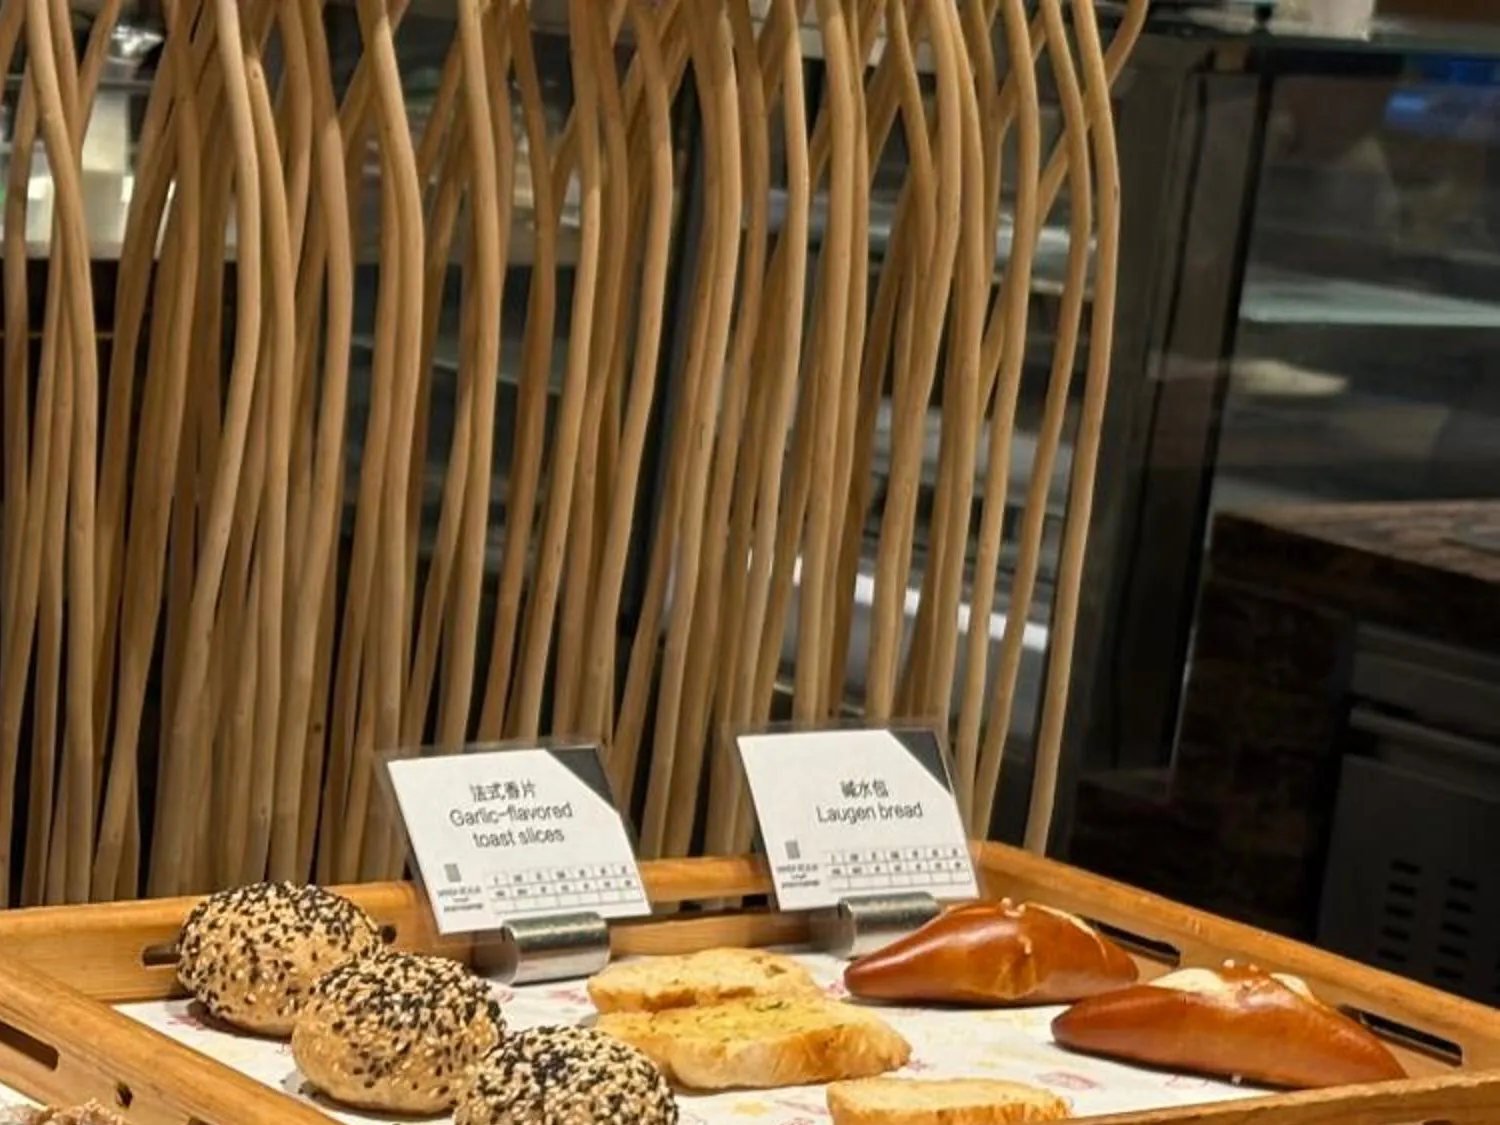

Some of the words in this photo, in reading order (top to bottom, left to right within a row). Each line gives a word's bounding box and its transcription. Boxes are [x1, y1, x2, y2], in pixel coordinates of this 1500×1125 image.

[449, 802, 573, 827] Garlic-flavored
[816, 805, 876, 824] Laugen
[878, 802, 923, 819] bread
[472, 829, 516, 848] toast
[518, 827, 564, 844] slices
